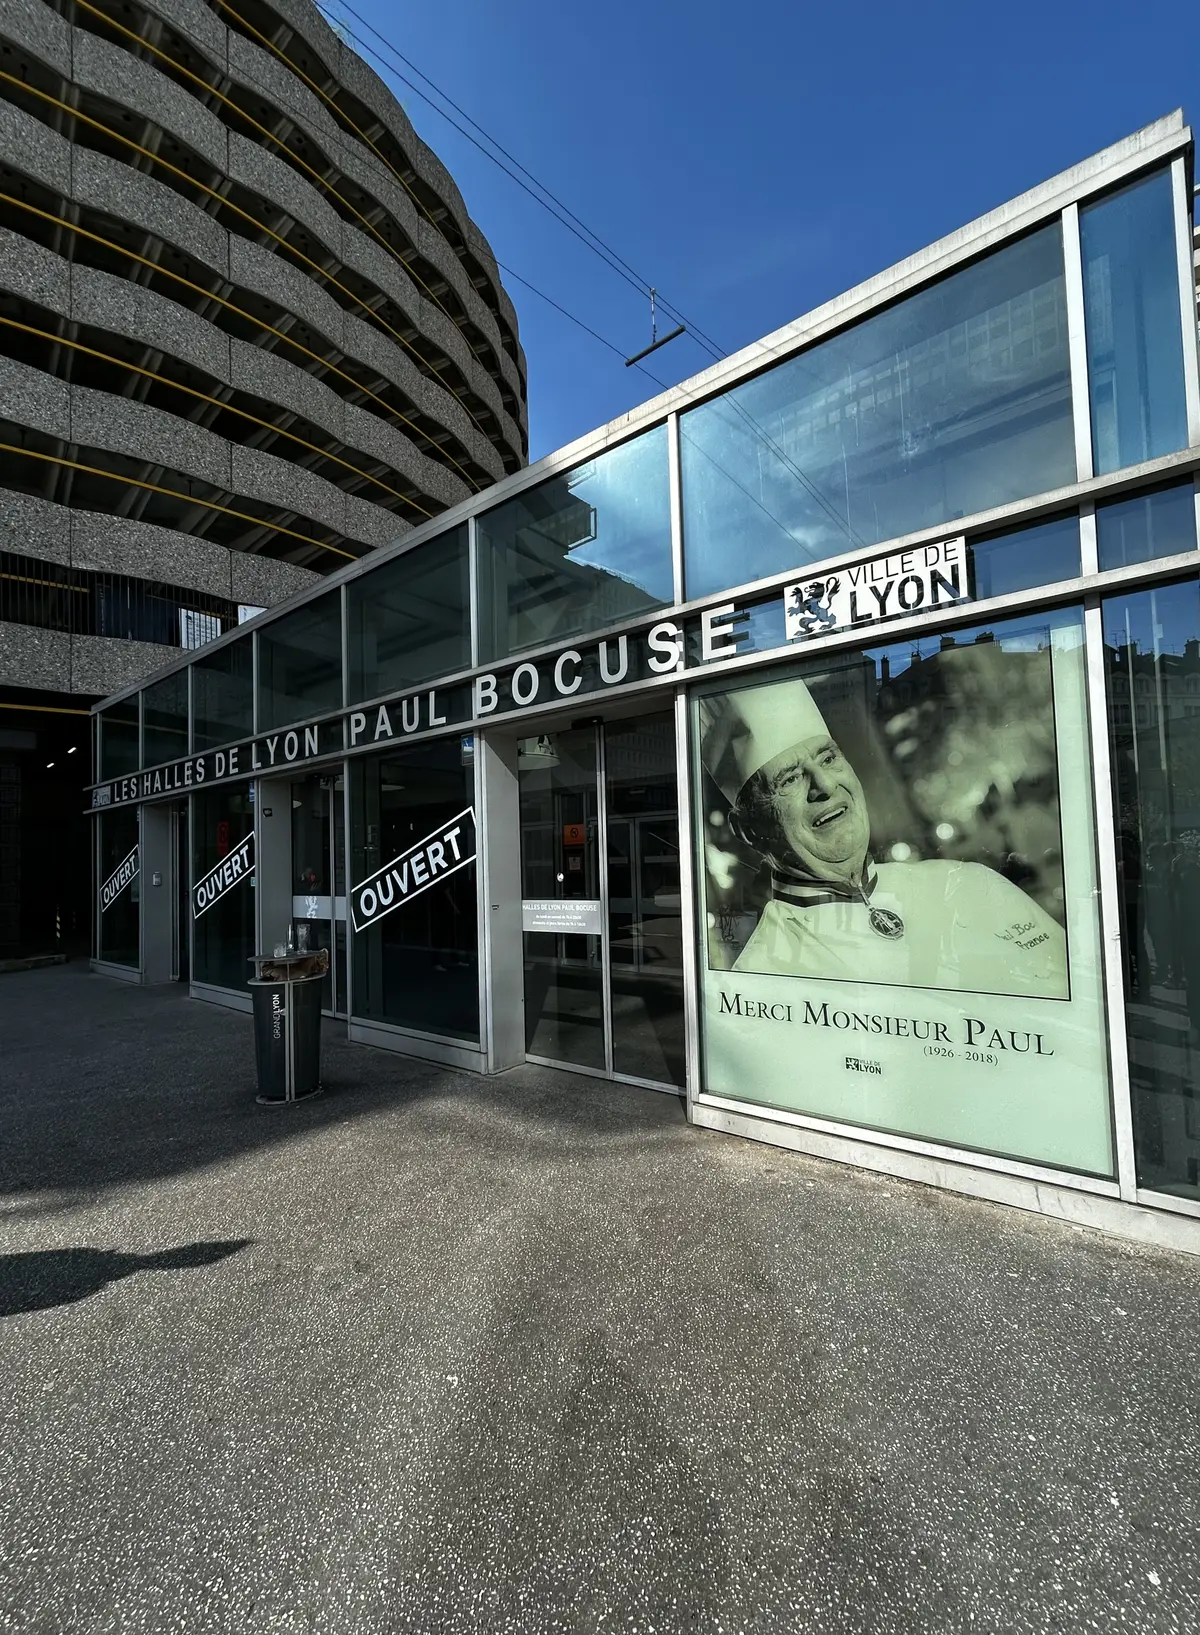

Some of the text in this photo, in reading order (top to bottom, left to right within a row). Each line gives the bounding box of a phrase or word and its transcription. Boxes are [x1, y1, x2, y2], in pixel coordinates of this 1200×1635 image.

[847, 539, 959, 587] VILLE DE
[849, 563, 961, 624] LYON
[114, 777, 137, 802] LES
[144, 757, 205, 795] HALLES
[215, 747, 239, 778] DE
[252, 725, 319, 769] LYON
[350, 690, 447, 746] PAUL
[475, 603, 737, 716] BOCUSE
[103, 854, 135, 904] OUVERT
[197, 844, 249, 909] OUVERT
[359, 826, 465, 917] OUVERT
[576, 904, 598, 912] BOCUSE
[860, 1064, 881, 1075] LYON
